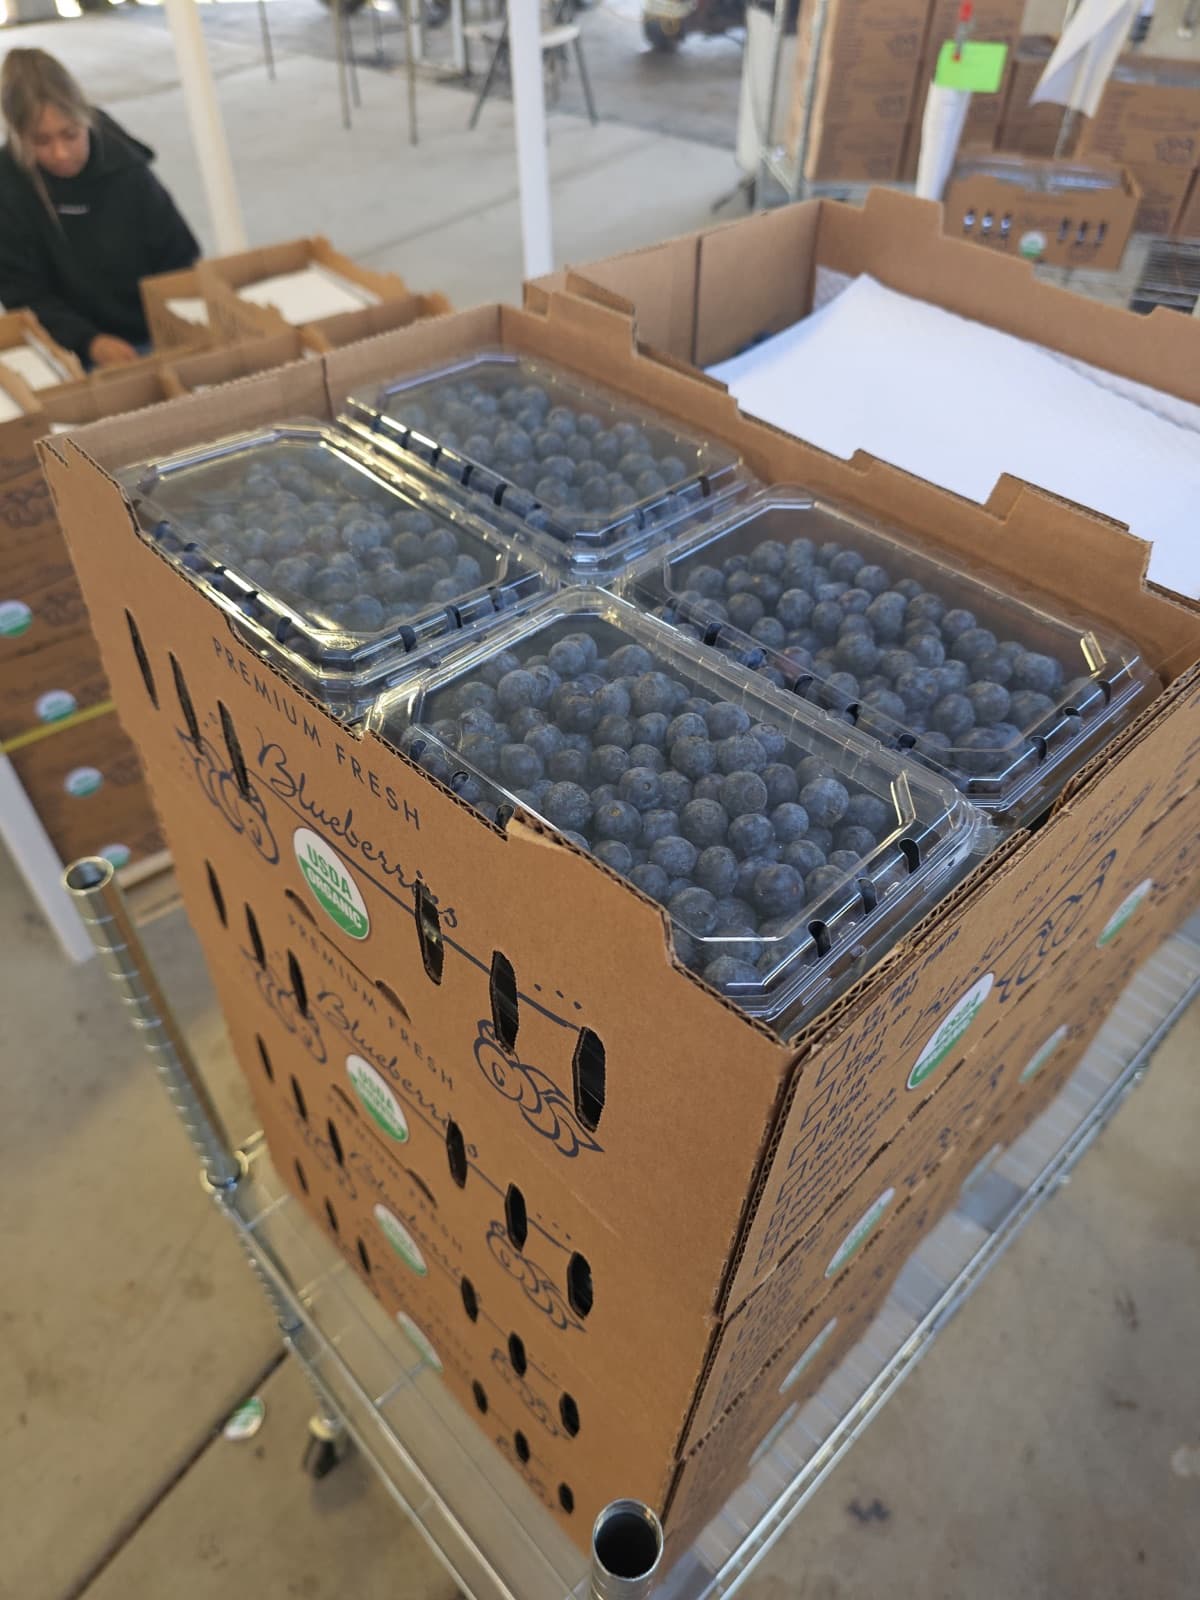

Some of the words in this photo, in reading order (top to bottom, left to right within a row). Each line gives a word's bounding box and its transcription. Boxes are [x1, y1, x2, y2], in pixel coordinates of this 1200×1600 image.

[212, 637, 322, 748] PREMIUM
[335, 742, 421, 831] FRESH
[255, 726, 458, 929] Blueberris
[306, 843, 353, 901] USDA
[387, 1015, 453, 1091] FRESH
